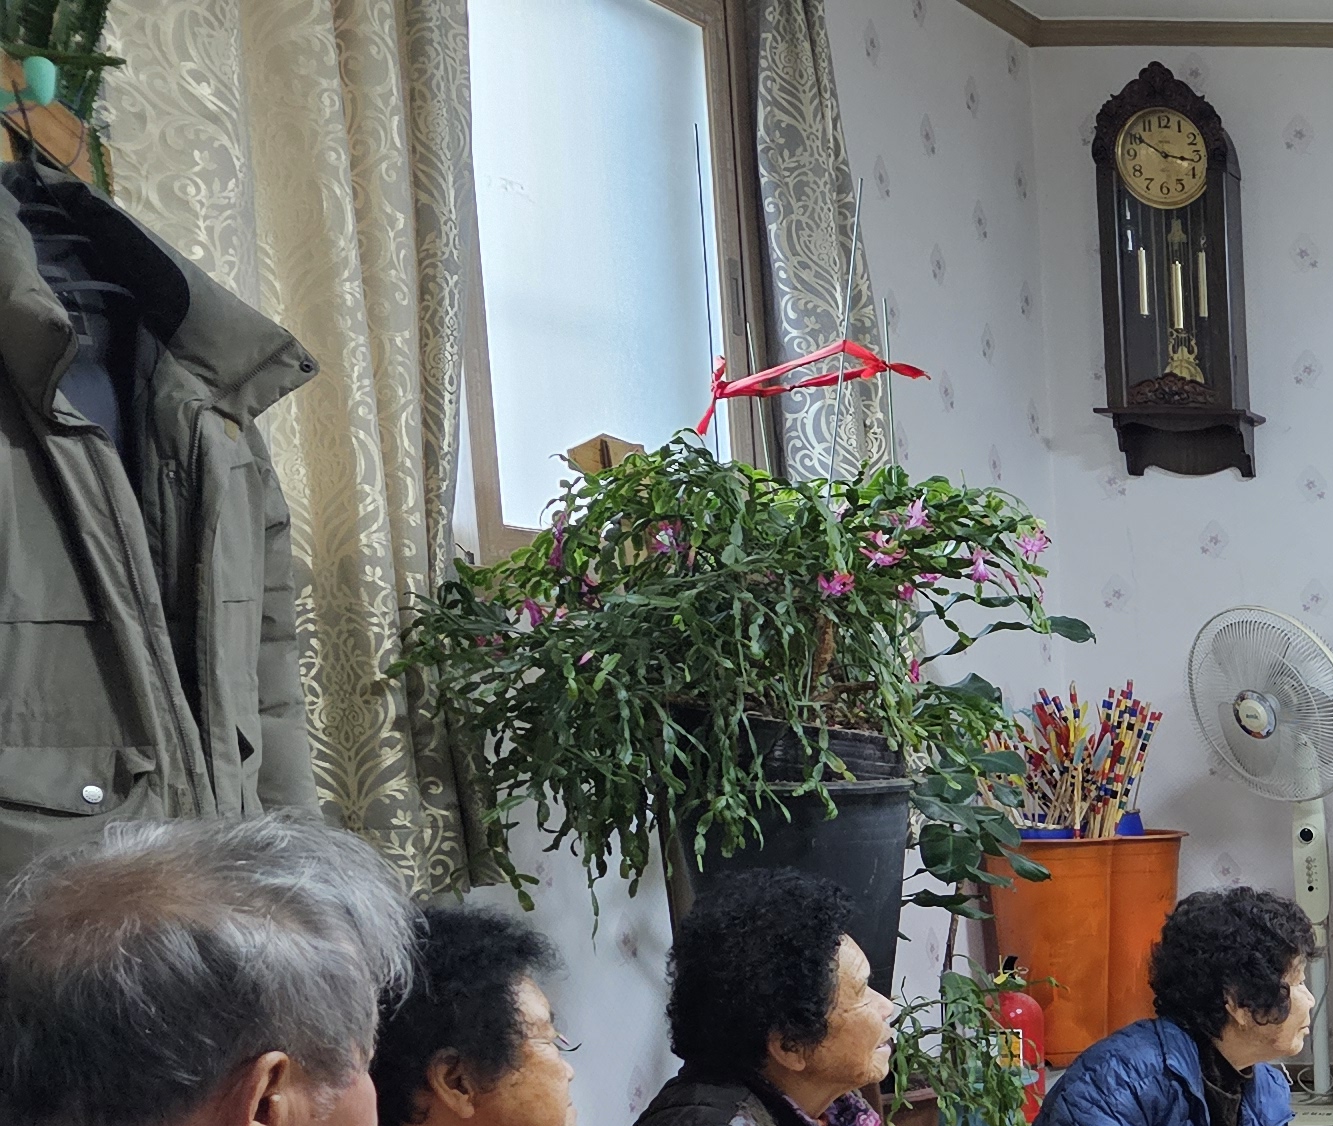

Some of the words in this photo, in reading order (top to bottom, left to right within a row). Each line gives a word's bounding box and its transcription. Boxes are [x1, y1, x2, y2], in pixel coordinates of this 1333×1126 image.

[1143, 120, 1152, 132] 11
[1158, 115, 1170, 128] 12
[1177, 120, 1181, 132] 1
[1130, 133, 1142, 145] 10
[1187, 132, 1197, 145] 2
[1127, 148, 1137, 160] 9
[1192, 150, 1201, 162] 3
[1133, 164, 1143, 177] 8
[1185, 166, 1197, 179] 4
[1144, 178, 1154, 191] 7
[1160, 181, 1170, 195] 6
[1175, 179, 1185, 192] 5
